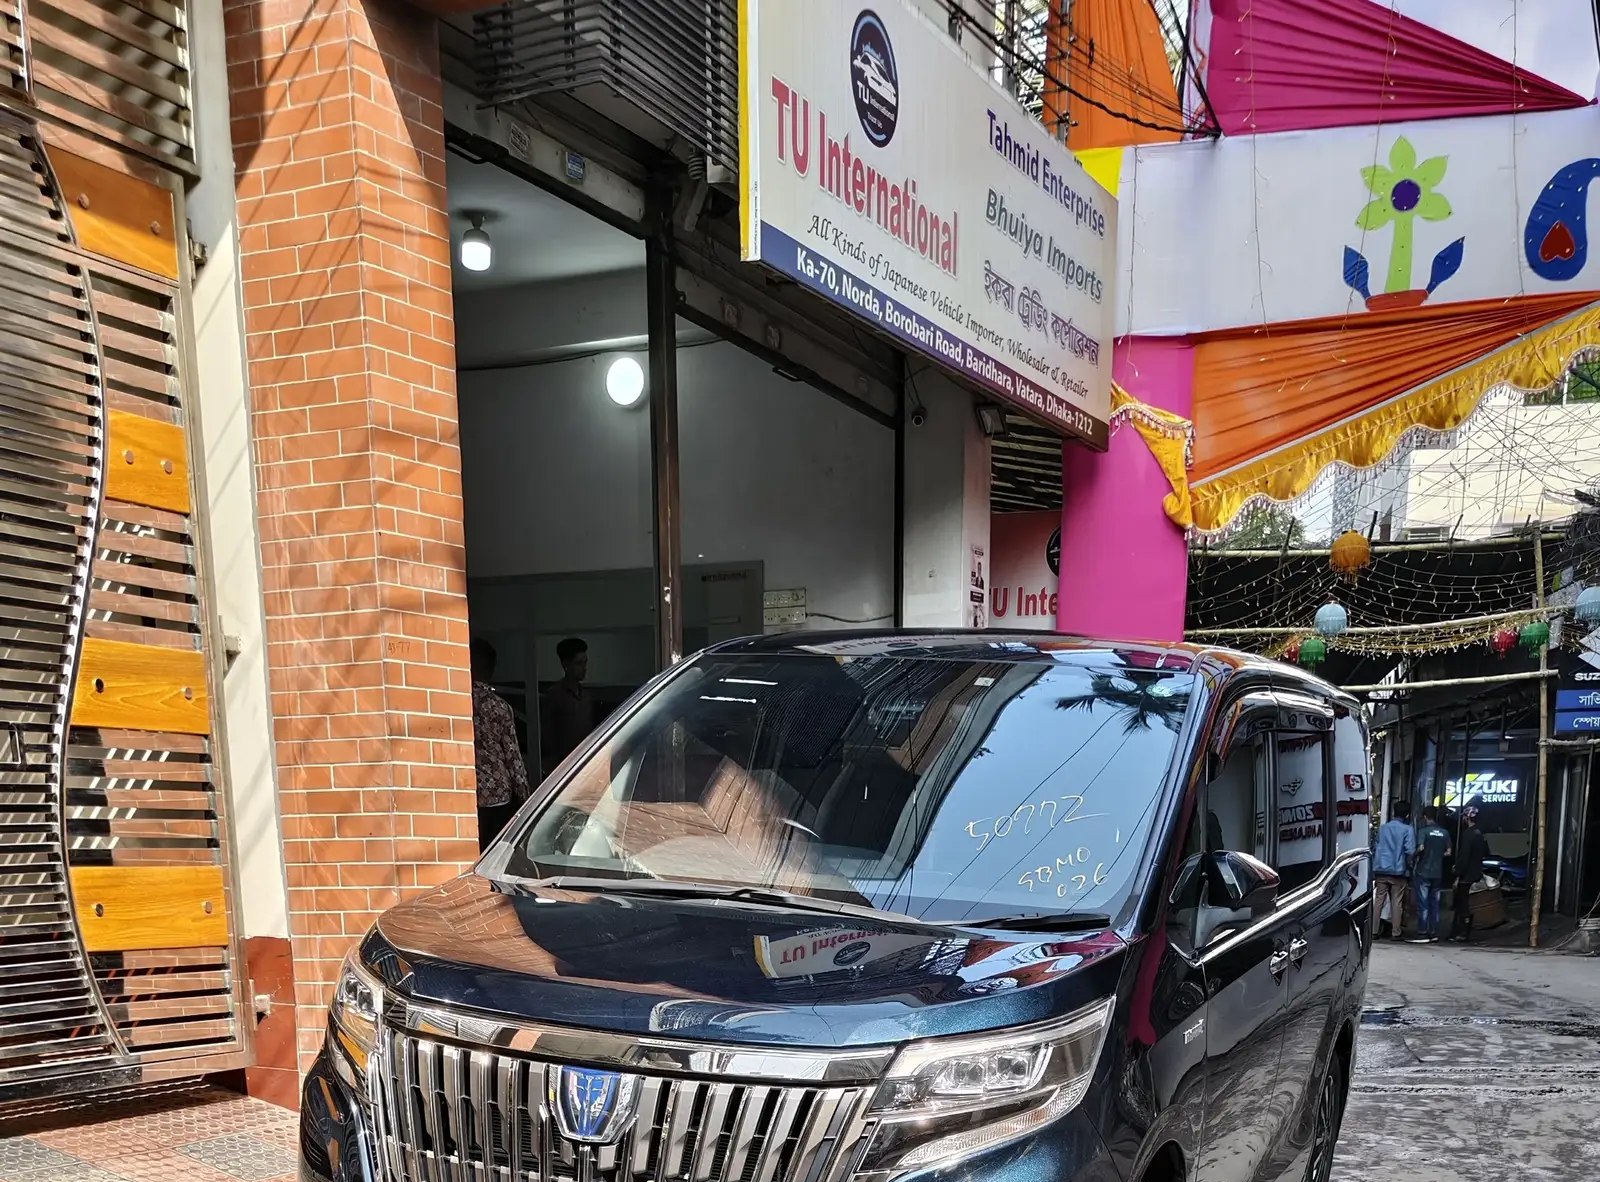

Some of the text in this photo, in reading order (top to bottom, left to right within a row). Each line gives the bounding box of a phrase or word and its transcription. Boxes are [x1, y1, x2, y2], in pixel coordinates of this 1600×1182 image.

[857, 80, 869, 104] TU
[771, 73, 810, 178] TU
[818, 108, 959, 279] International
[986, 107, 1106, 239] Tahmid Enterprise
[985, 187, 1104, 303] Bhuiya Imports
[796, 246, 1094, 436] Ka-70, Norda, Borobari Road, Baridhara, Vatara, Dhaka-1212
[807, 214, 1089, 399] All Kinds of Japanese Vehicle Importer, Wholesaler & Retailer
[989, 587, 1009, 618] U
[1445, 780, 1518, 794] SUZUKI
[1482, 794, 1517, 803] SERVICE
